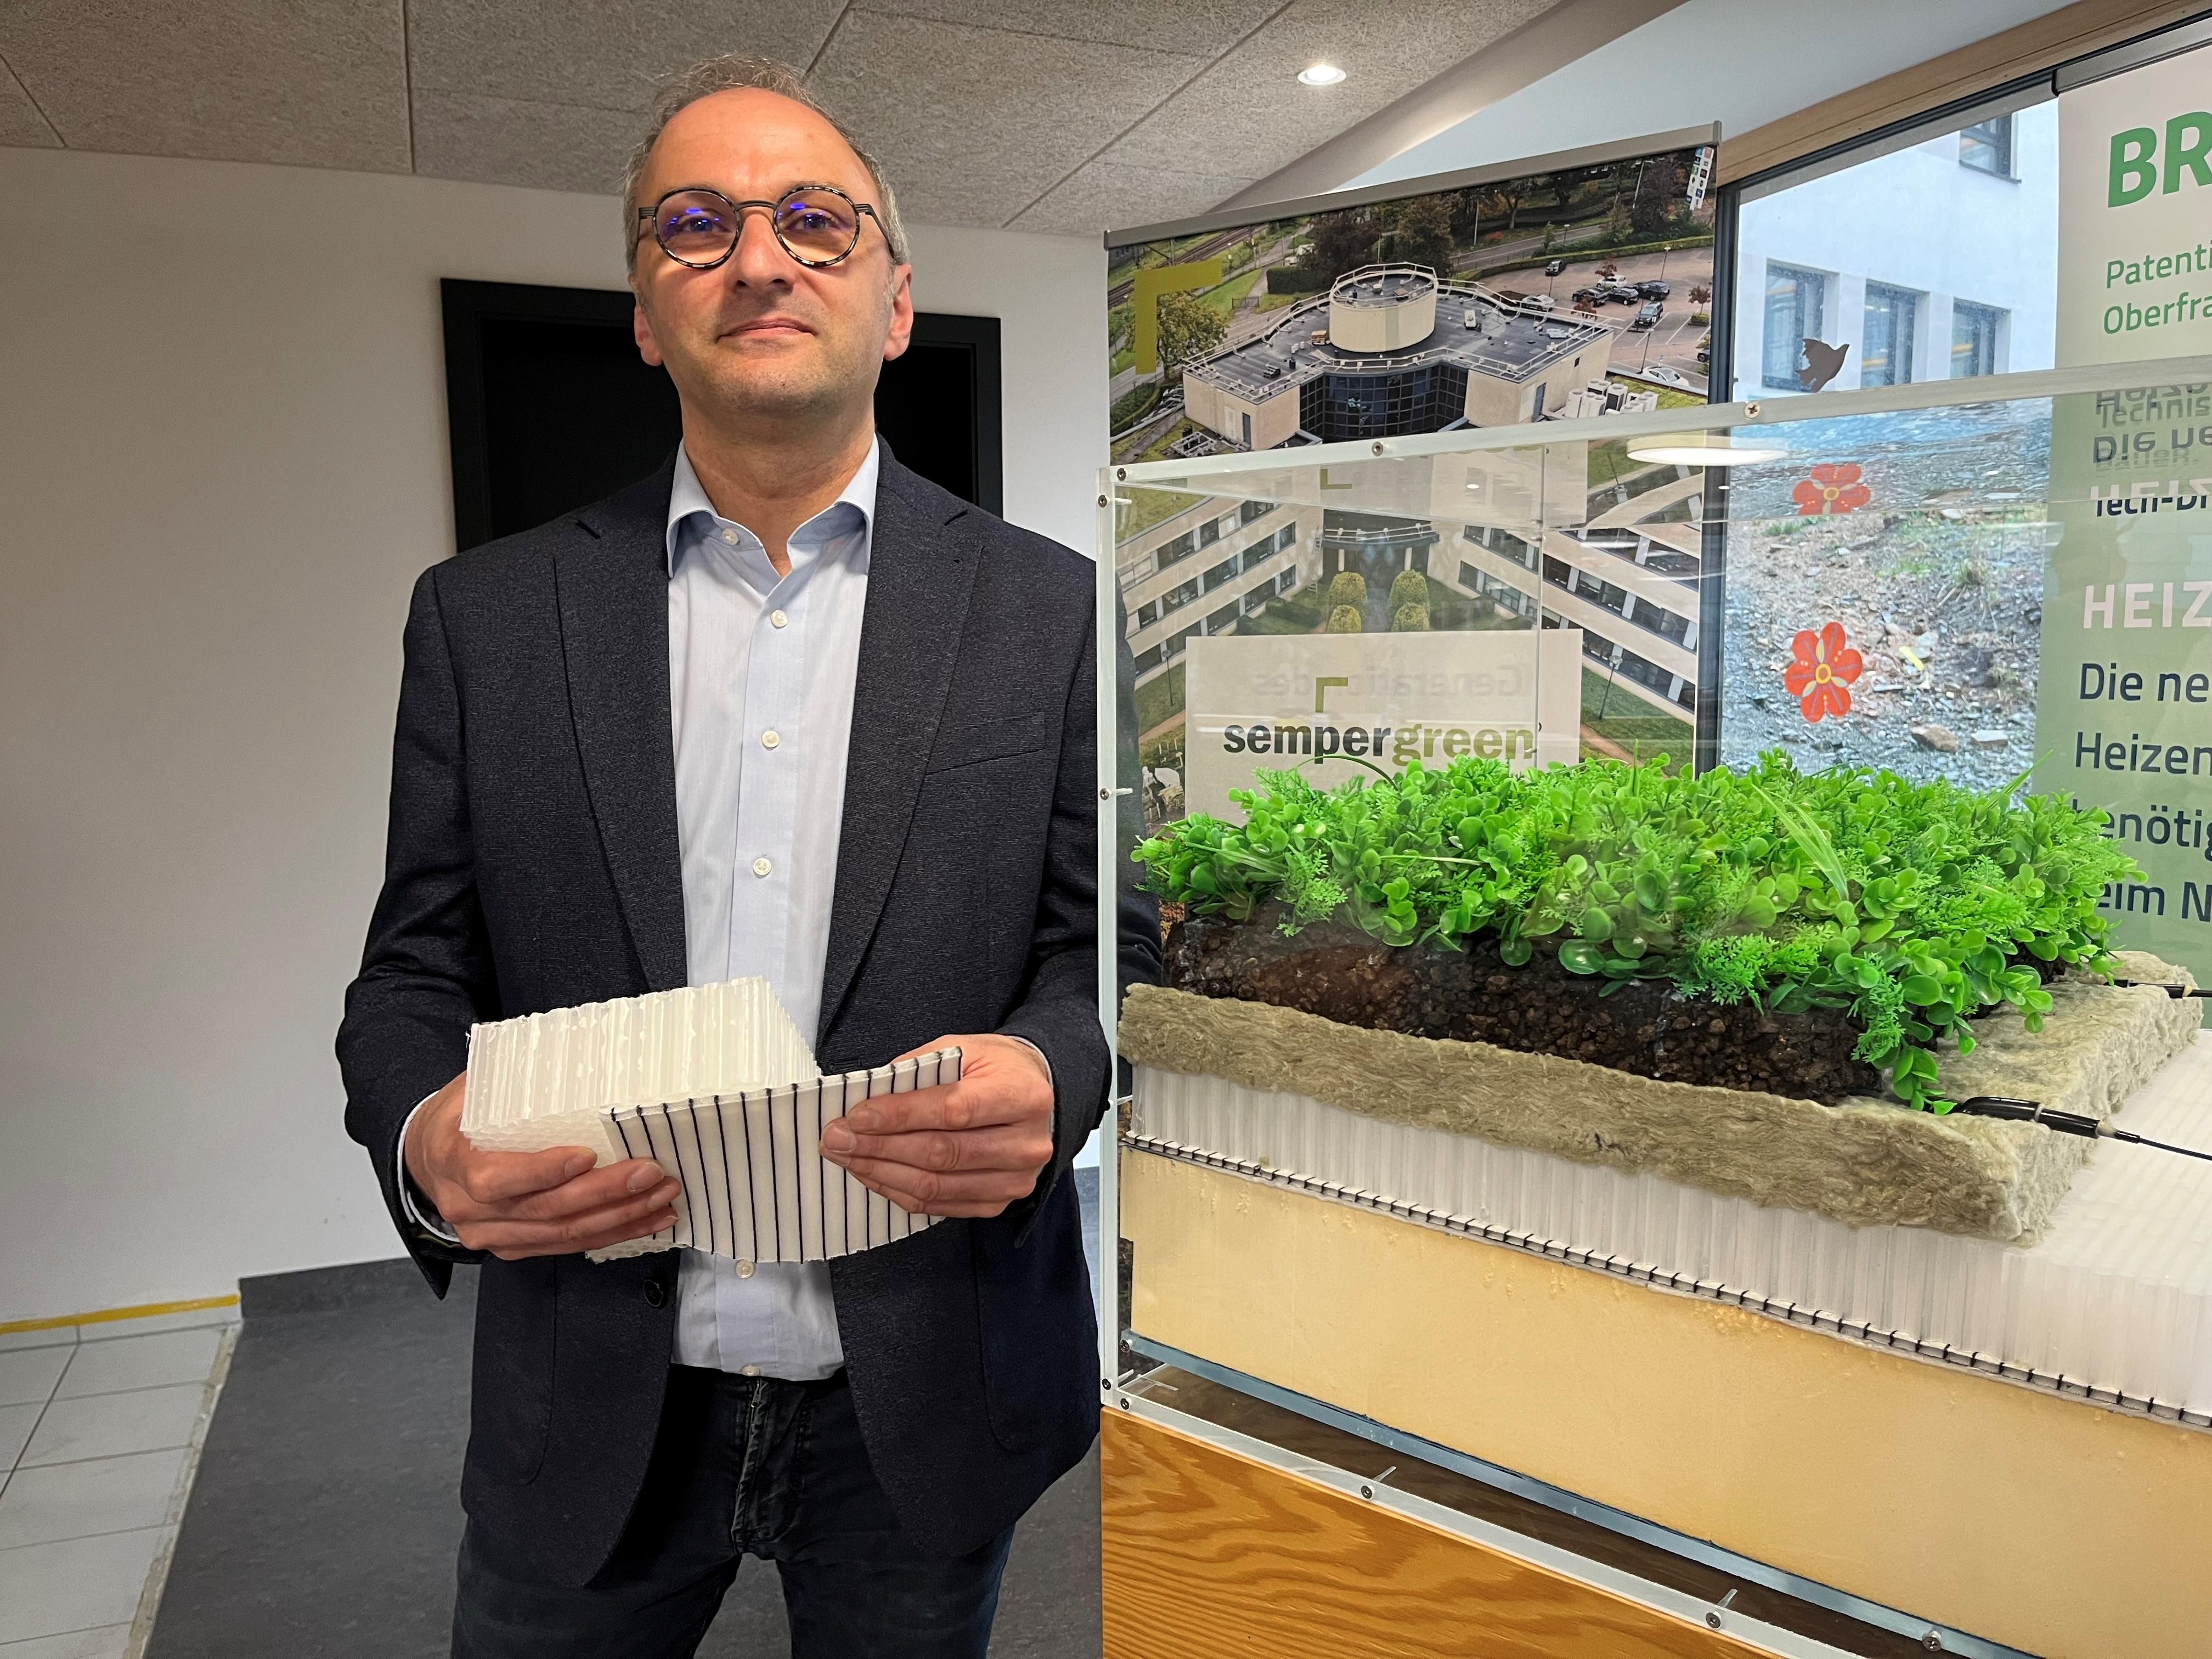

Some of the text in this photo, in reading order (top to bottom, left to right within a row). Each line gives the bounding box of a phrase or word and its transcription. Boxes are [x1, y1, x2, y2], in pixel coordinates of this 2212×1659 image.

[2108, 111, 2212, 207] BR
[2103, 292, 2212, 334] Oberfra
[2083, 582, 2212, 629] HEIZ
[2080, 663, 2209, 702] Die ne
[1223, 723, 1534, 766] sempergreen
[2075, 732, 2212, 776] Heizen
[2072, 799, 2212, 861] enöti
[2097, 882, 2165, 916] eim
